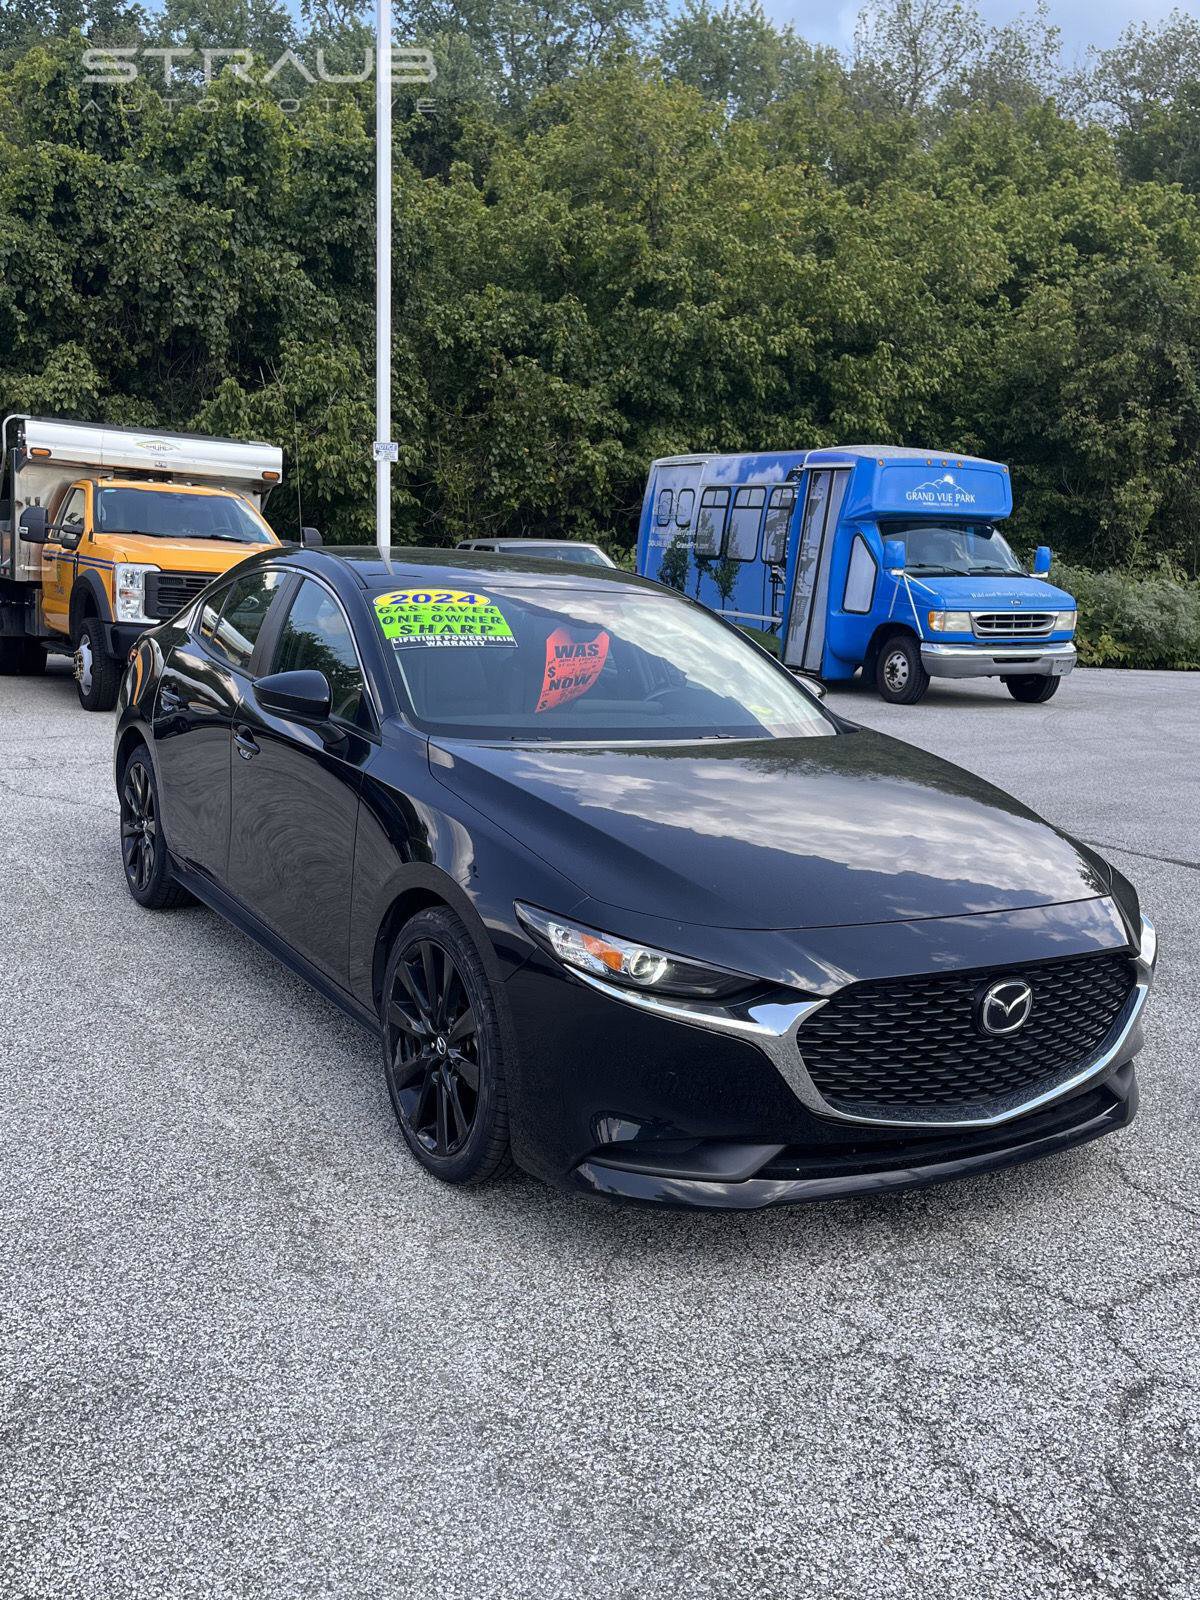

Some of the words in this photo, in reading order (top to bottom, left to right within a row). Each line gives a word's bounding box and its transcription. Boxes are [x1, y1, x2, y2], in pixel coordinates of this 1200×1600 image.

[905, 491, 935, 502] GRAND
[936, 492, 953, 503] VUE
[955, 493, 976, 504] PARK
[389, 593, 478, 605] 2024
[378, 605, 496, 614] GAS-SAVER
[382, 614, 424, 625] ONE
[431, 614, 503, 624] OWNER
[400, 624, 494, 635] SHARP
[393, 635, 442, 644] LIFETIME
[554, 643, 599, 659] WAS
[548, 674, 592, 691] NOW
